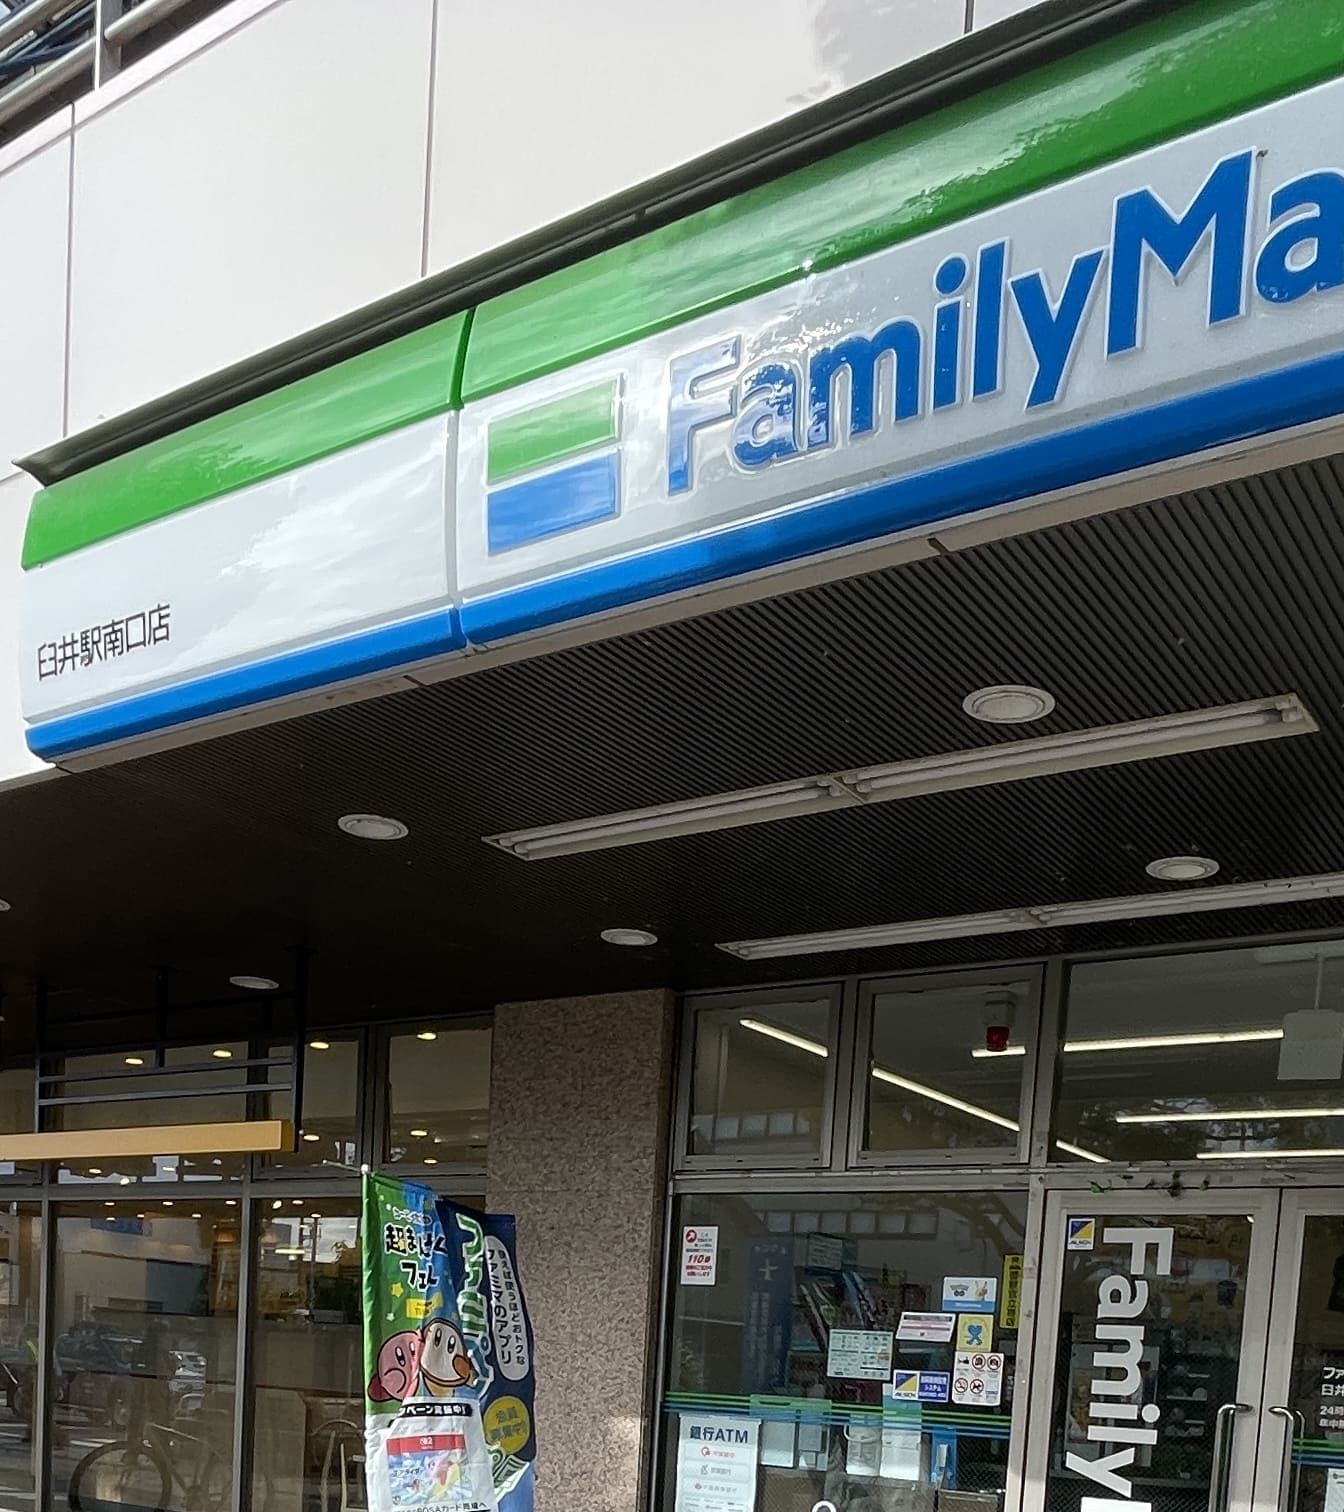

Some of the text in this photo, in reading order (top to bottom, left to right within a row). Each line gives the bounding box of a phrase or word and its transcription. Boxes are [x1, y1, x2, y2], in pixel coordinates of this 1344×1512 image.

[36, 603, 171, 681] 臼井駅南口店
[488, 1249, 512, 1364] ファミマのアプリ
[689, 1425, 749, 1444] 銀行ATM
